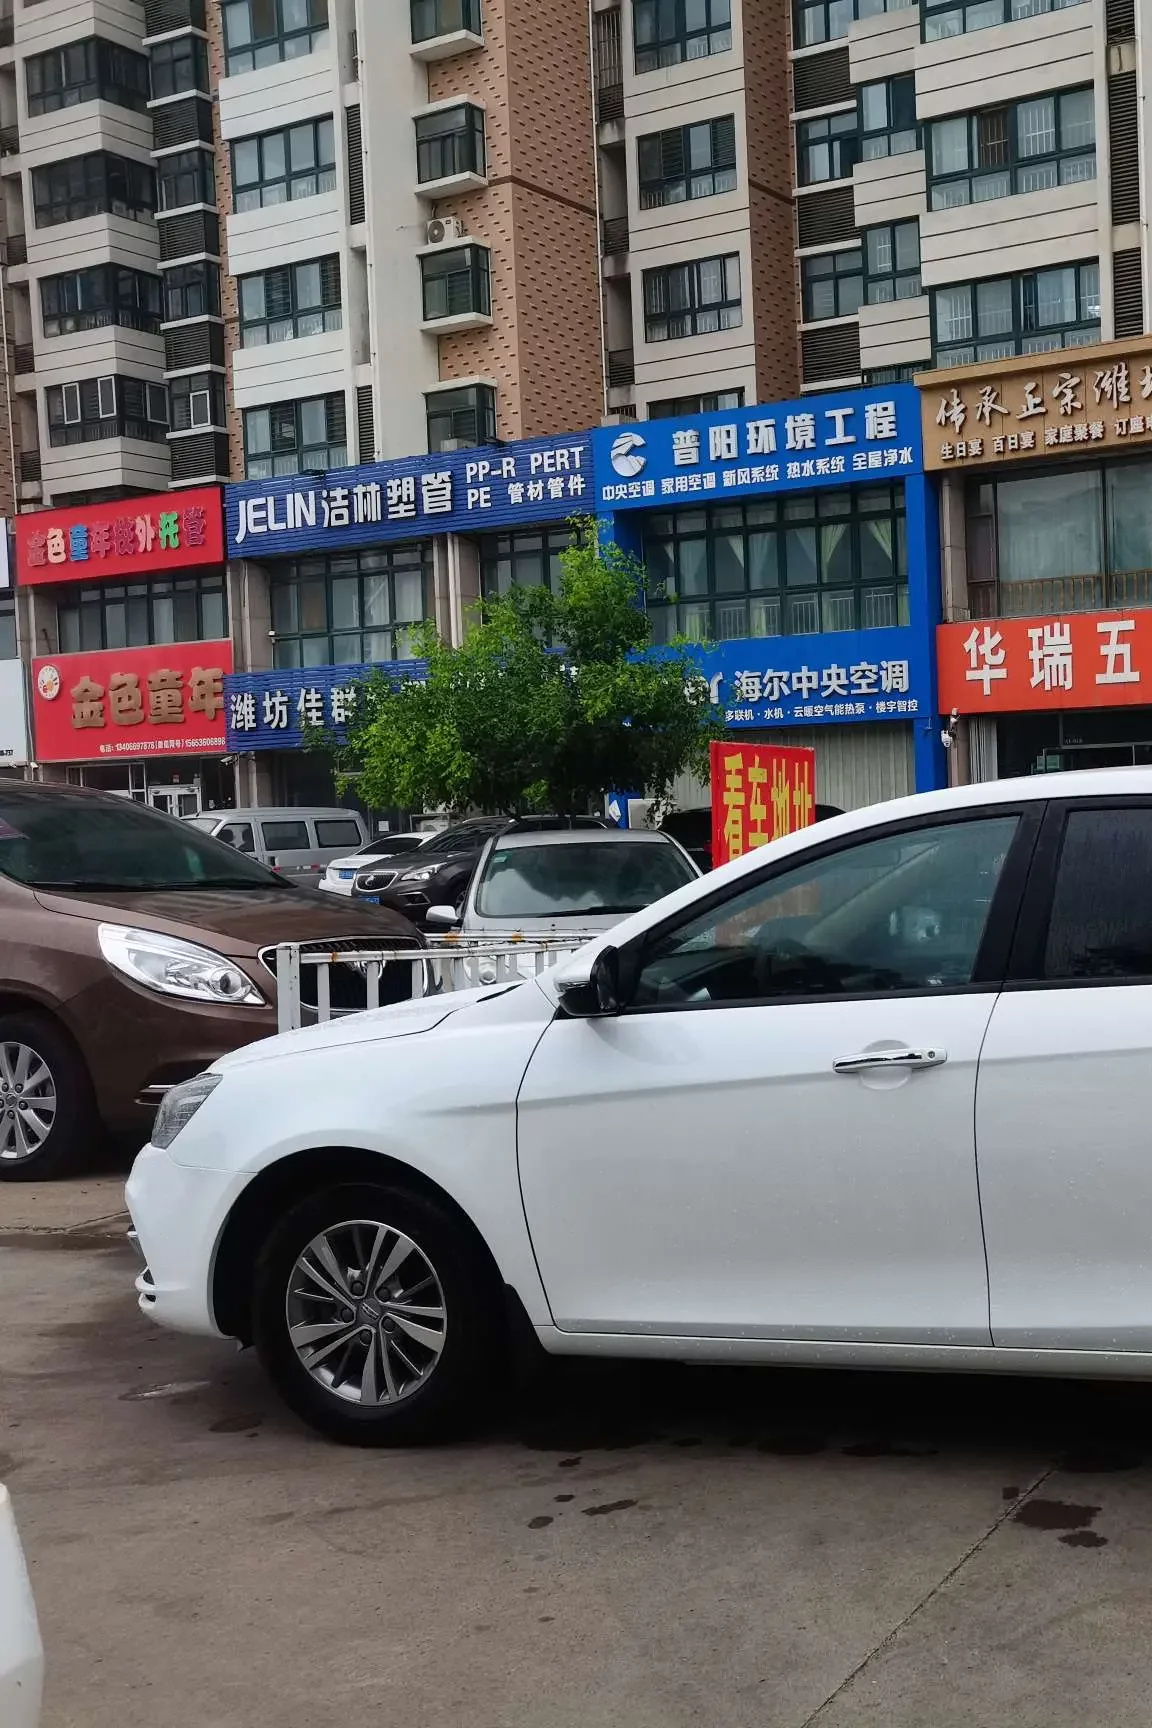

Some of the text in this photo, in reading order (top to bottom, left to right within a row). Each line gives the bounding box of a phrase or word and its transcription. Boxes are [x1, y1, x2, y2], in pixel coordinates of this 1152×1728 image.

[672, 401, 898, 466] 普阳环境工程
[941, 438, 983, 461] 生日宴
[991, 430, 1036, 453] 百日宴
[1044, 420, 1105, 446] 家庭聚餐
[465, 446, 585, 484] PP-R PERT
[602, 446, 914, 501] 中央空调 家用空调 新风系统 热水系统 全屋净水
[235, 471, 452, 544] JELIN 洁林塑管
[467, 473, 586, 510] PE 管材管件
[71, 666, 225, 729] 金色童年
[734, 660, 910, 702] 海尔中央空调
